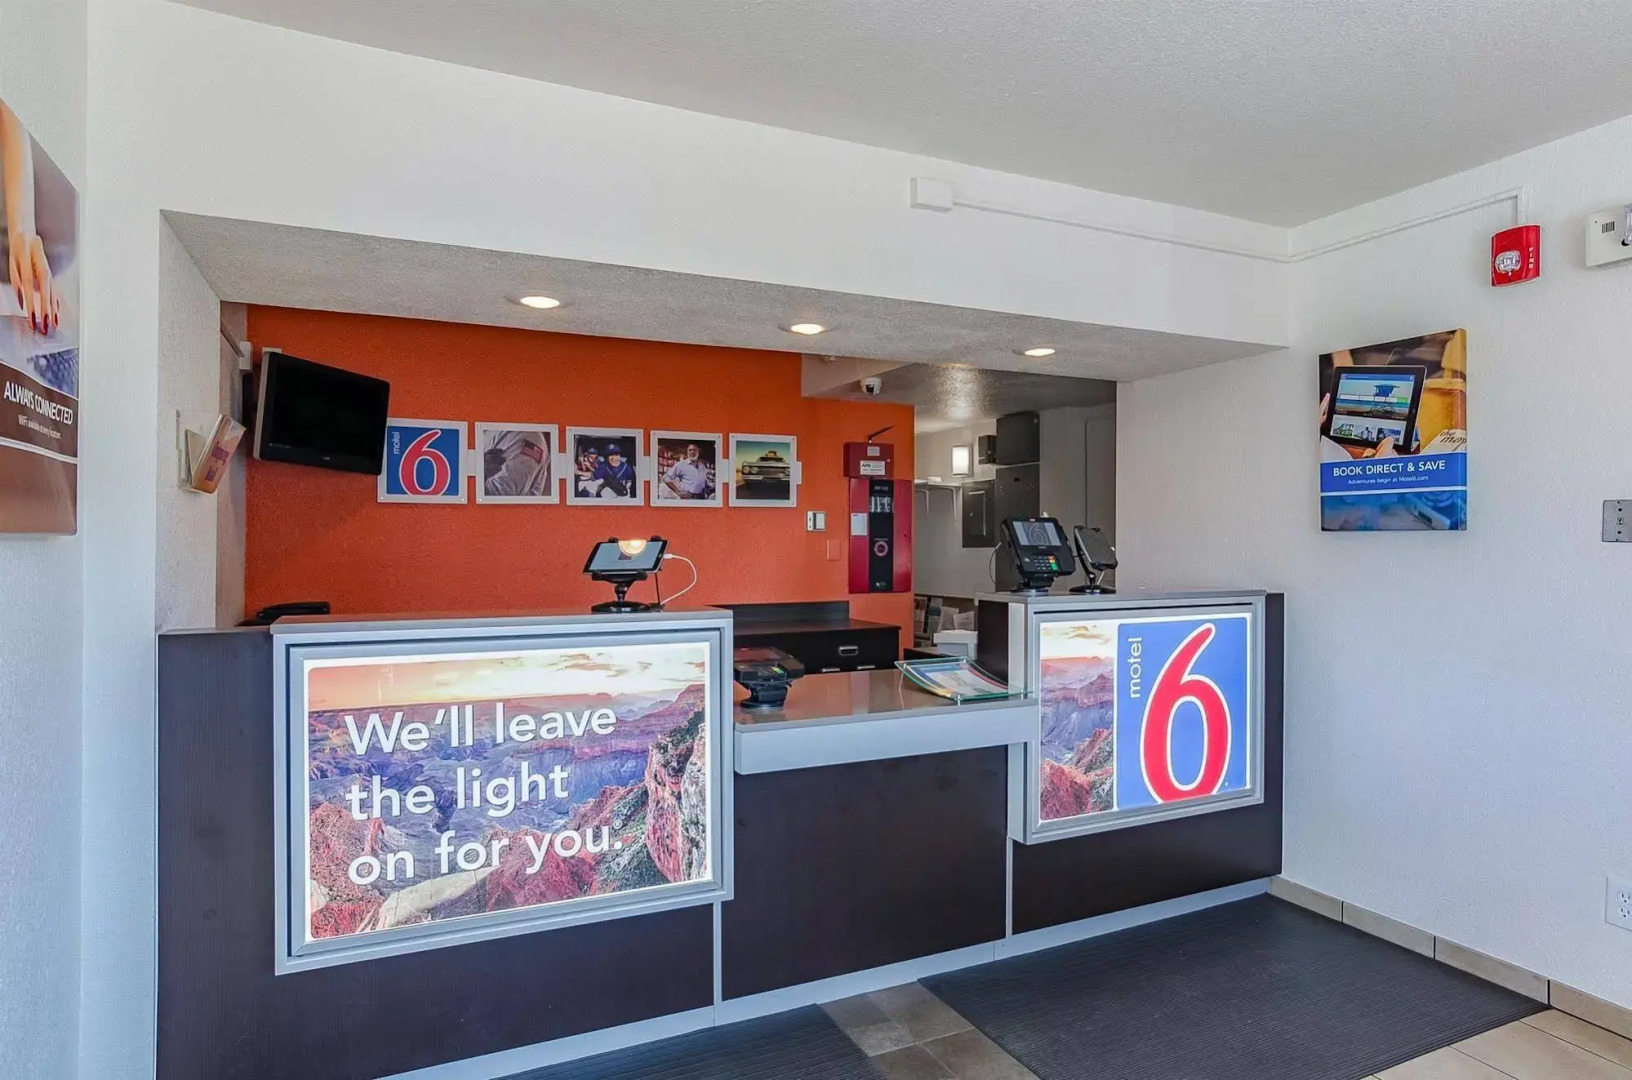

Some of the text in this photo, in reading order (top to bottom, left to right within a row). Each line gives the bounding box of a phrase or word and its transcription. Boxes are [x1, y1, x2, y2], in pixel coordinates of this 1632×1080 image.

[3, 380, 74, 426] ALWAYS CONNECTED
[392, 431, 400, 455] motel
[399, 429, 451, 496] 6
[1333, 460, 1446, 477] BOOK DIRECT & SAVE
[1127, 637, 1142, 698] motel
[345, 702, 617, 756] We'll leave
[1139, 622, 1232, 803] 6
[346, 761, 570, 821] the light
[348, 852, 415, 886] on
[435, 829, 511, 875] for
